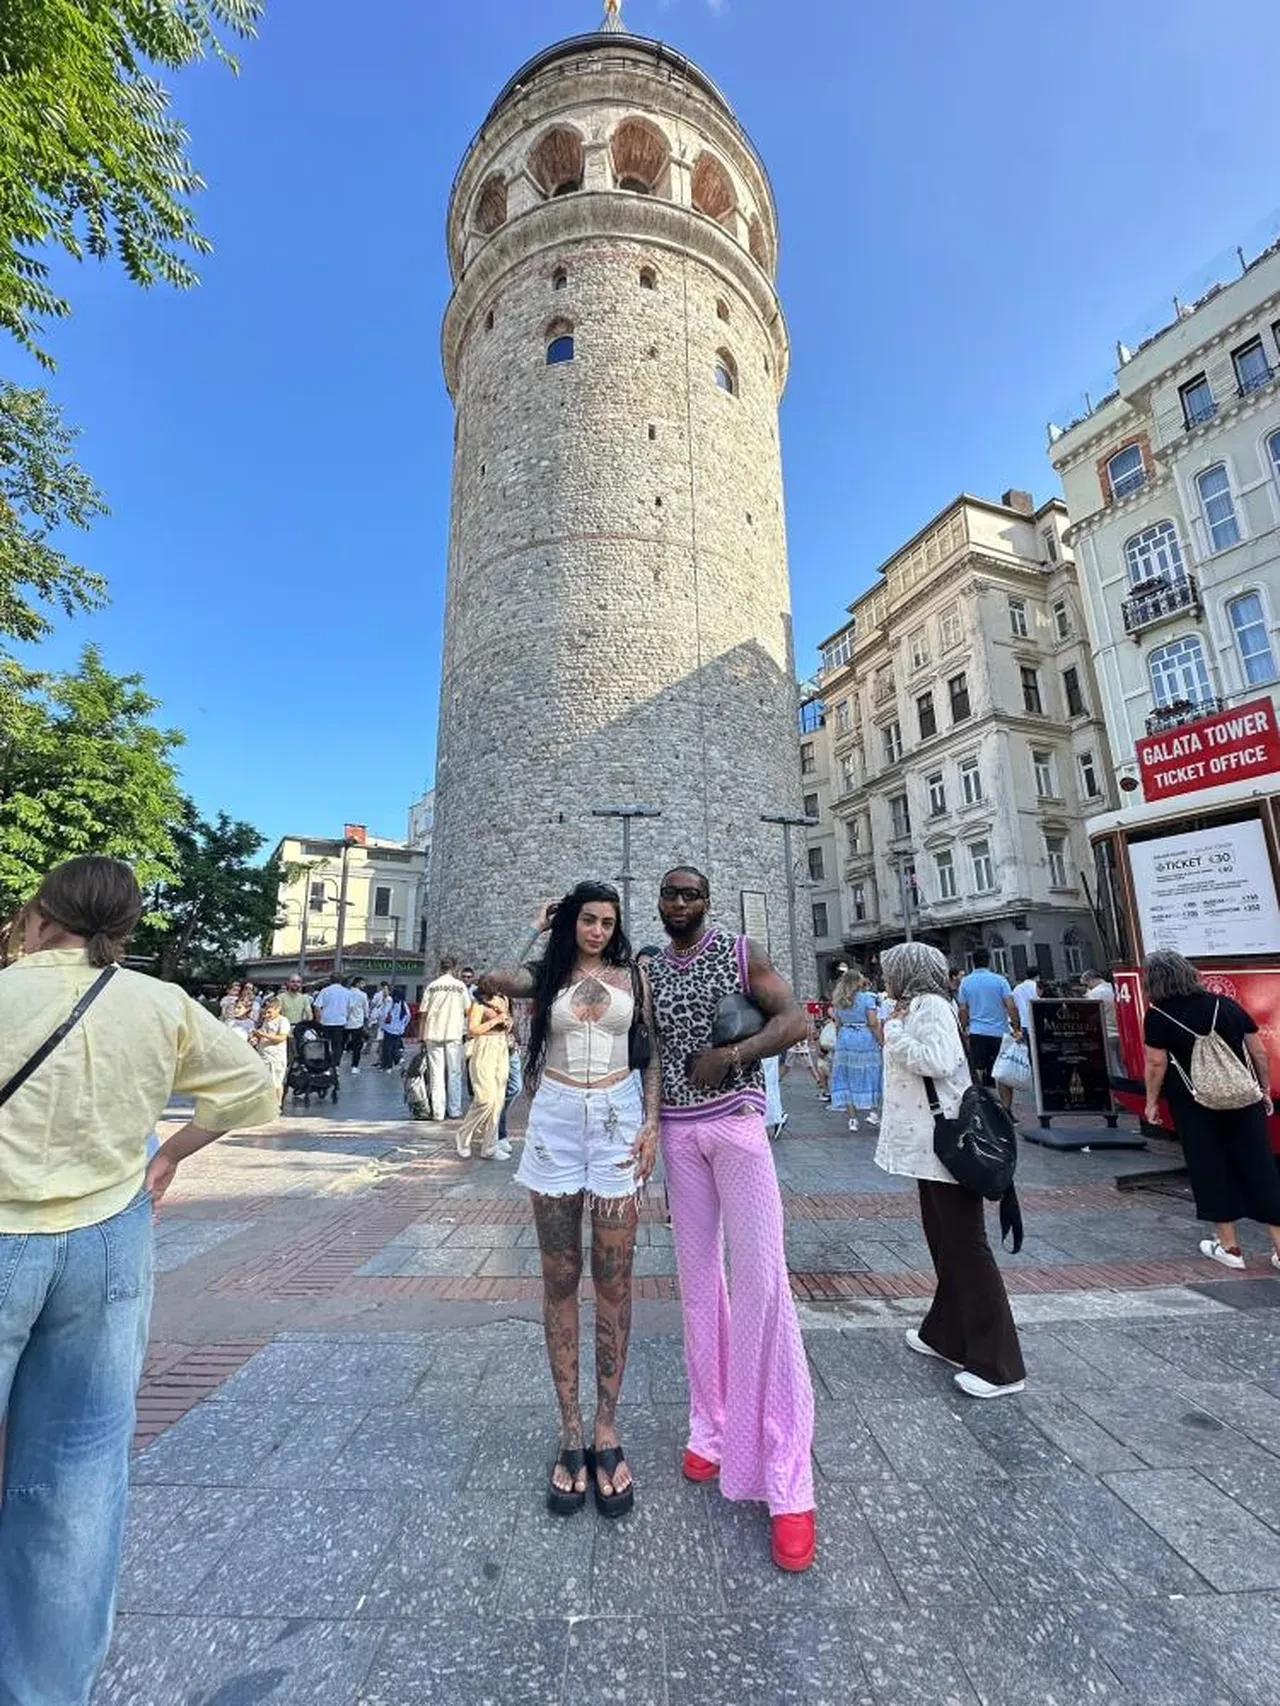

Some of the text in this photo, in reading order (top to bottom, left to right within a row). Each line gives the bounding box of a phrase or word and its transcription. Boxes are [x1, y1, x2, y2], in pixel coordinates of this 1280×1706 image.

[1143, 711, 1269, 766] GALATA TOWER
[1154, 744, 1268, 789] TICKET OFFICE
[1165, 857, 1202, 871] TICKET
